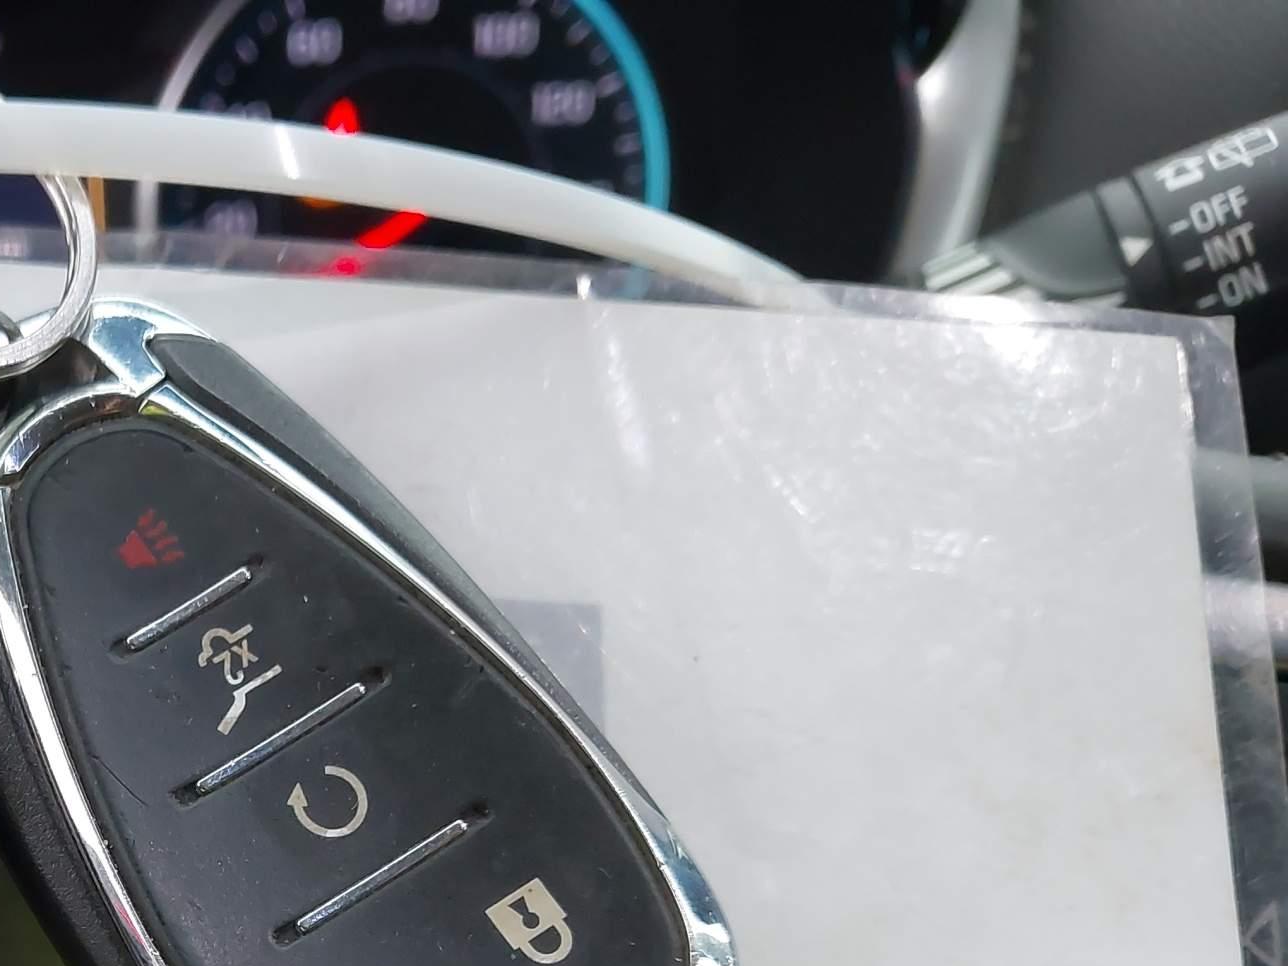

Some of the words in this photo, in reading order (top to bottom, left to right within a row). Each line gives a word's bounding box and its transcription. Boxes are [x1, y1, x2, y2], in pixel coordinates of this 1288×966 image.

[1189, 184, 1248, 234] OFF
[1202, 221, 1255, 271] INT
[1217, 261, 1269, 307] ON
